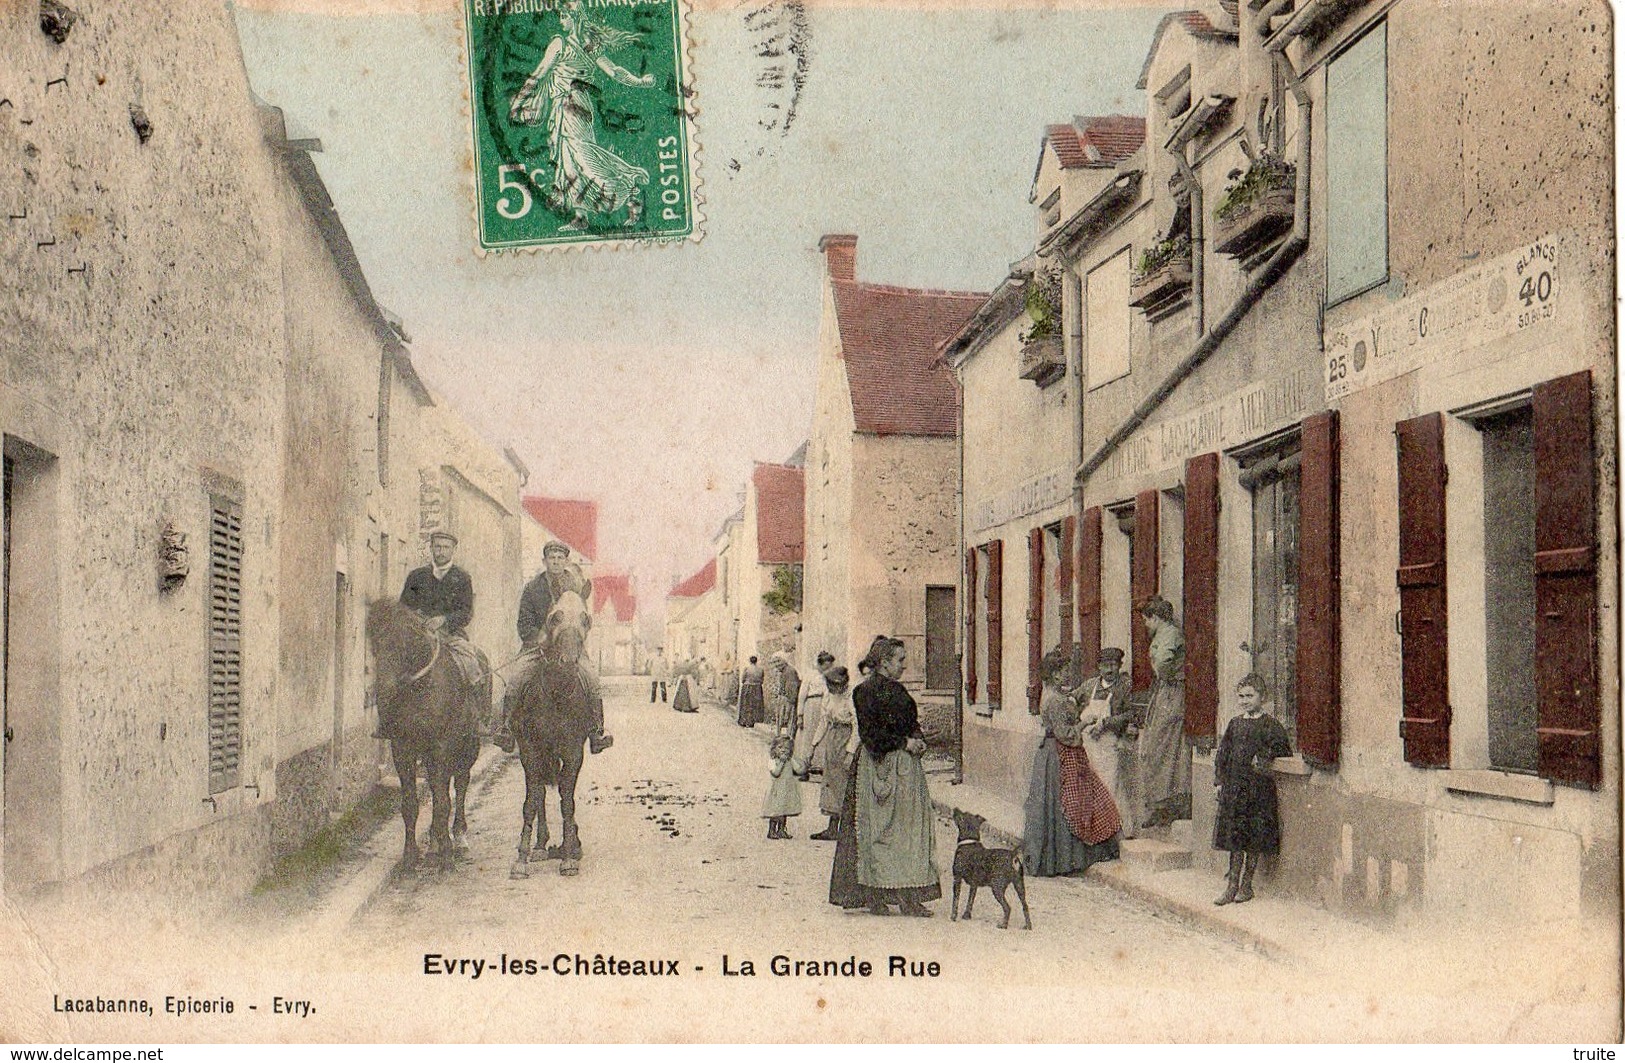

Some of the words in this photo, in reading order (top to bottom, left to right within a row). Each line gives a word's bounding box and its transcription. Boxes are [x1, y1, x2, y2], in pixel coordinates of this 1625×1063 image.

[661, 135, 681, 221] POSTES
[1516, 242, 1556, 275] BLANCS
[1518, 270, 1552, 307] 40
[1329, 355, 1347, 383] 25
